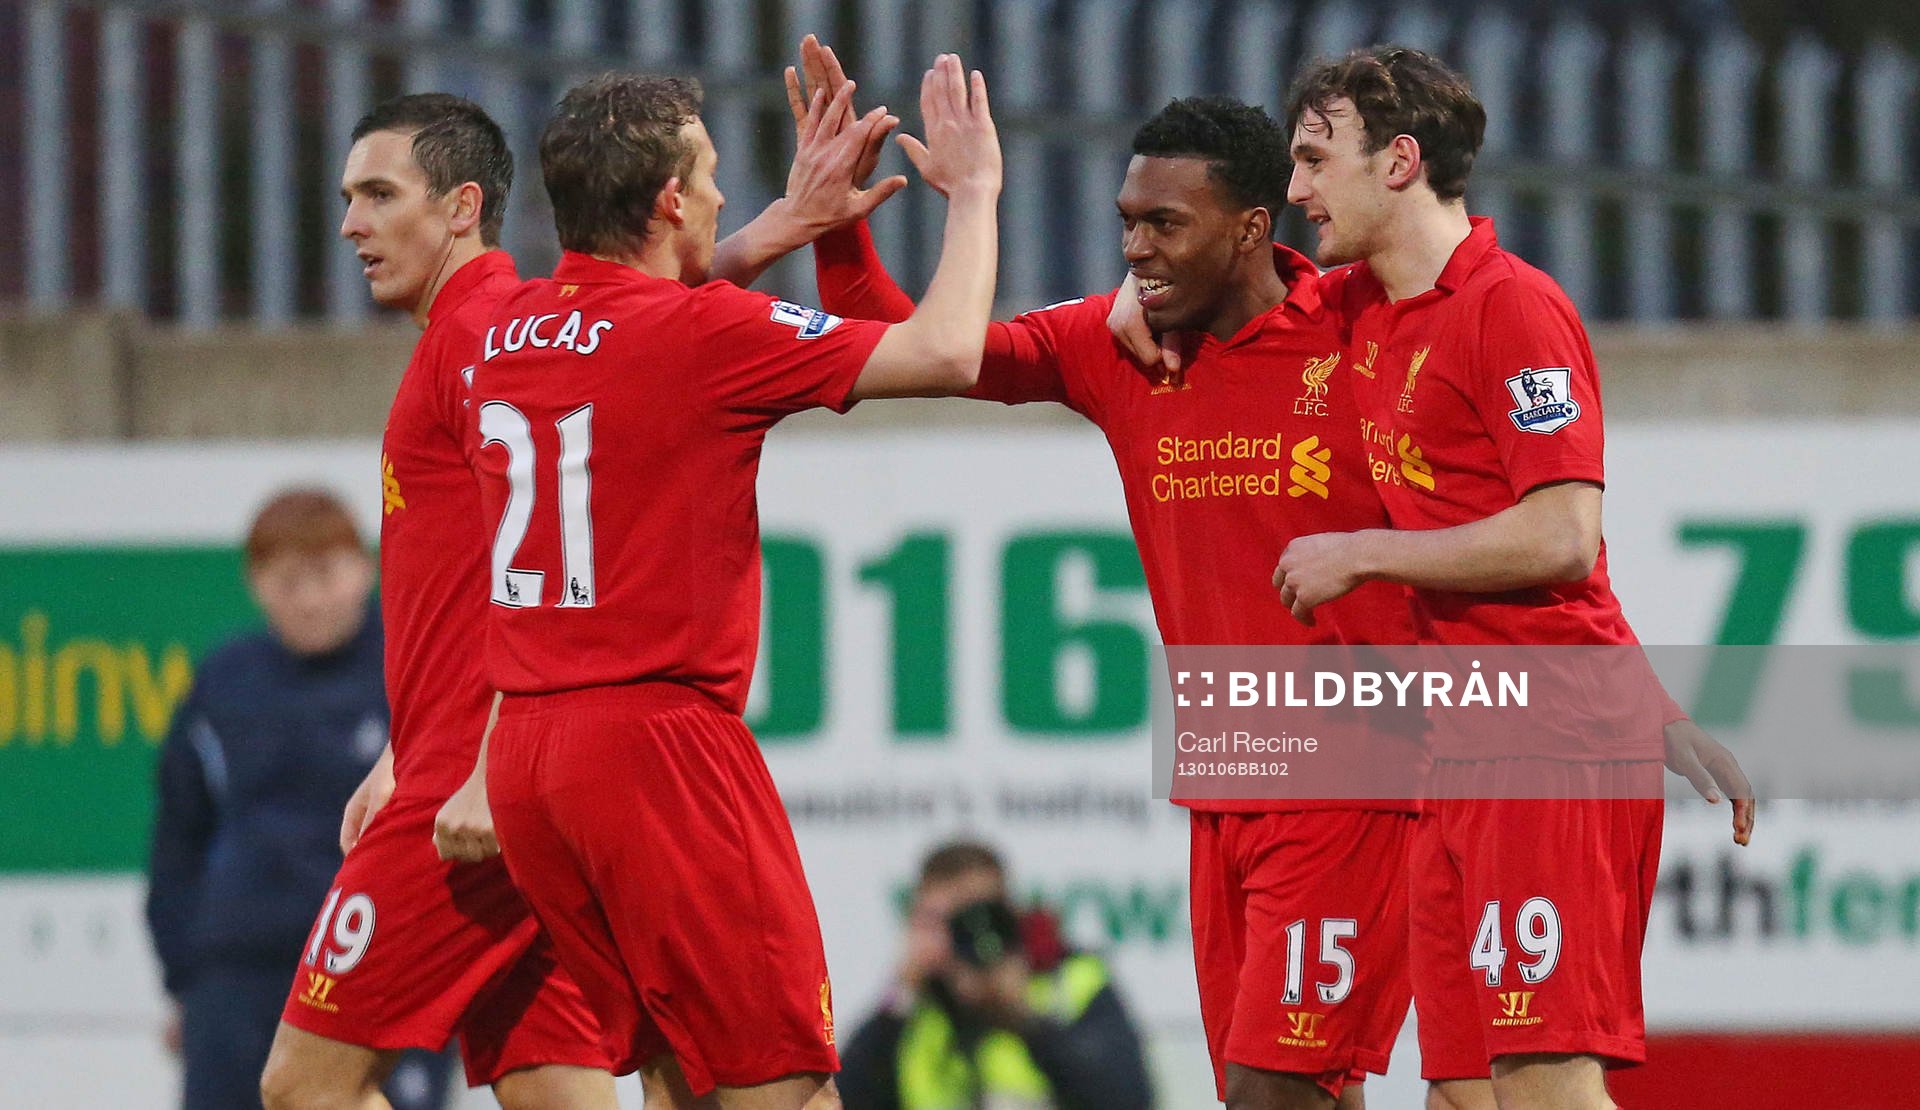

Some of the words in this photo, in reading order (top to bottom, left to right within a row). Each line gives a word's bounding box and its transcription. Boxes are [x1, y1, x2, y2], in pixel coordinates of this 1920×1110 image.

[483, 309, 614, 363] LUCAS
[1522, 404, 1561, 421] BARCLAYS
[1157, 431, 1282, 465] Standard
[479, 400, 596, 608] 21
[1152, 468, 1280, 502] Chartered
[305, 886, 377, 975] 19
[1281, 918, 1358, 1005] 15
[1470, 896, 1563, 987] 49
